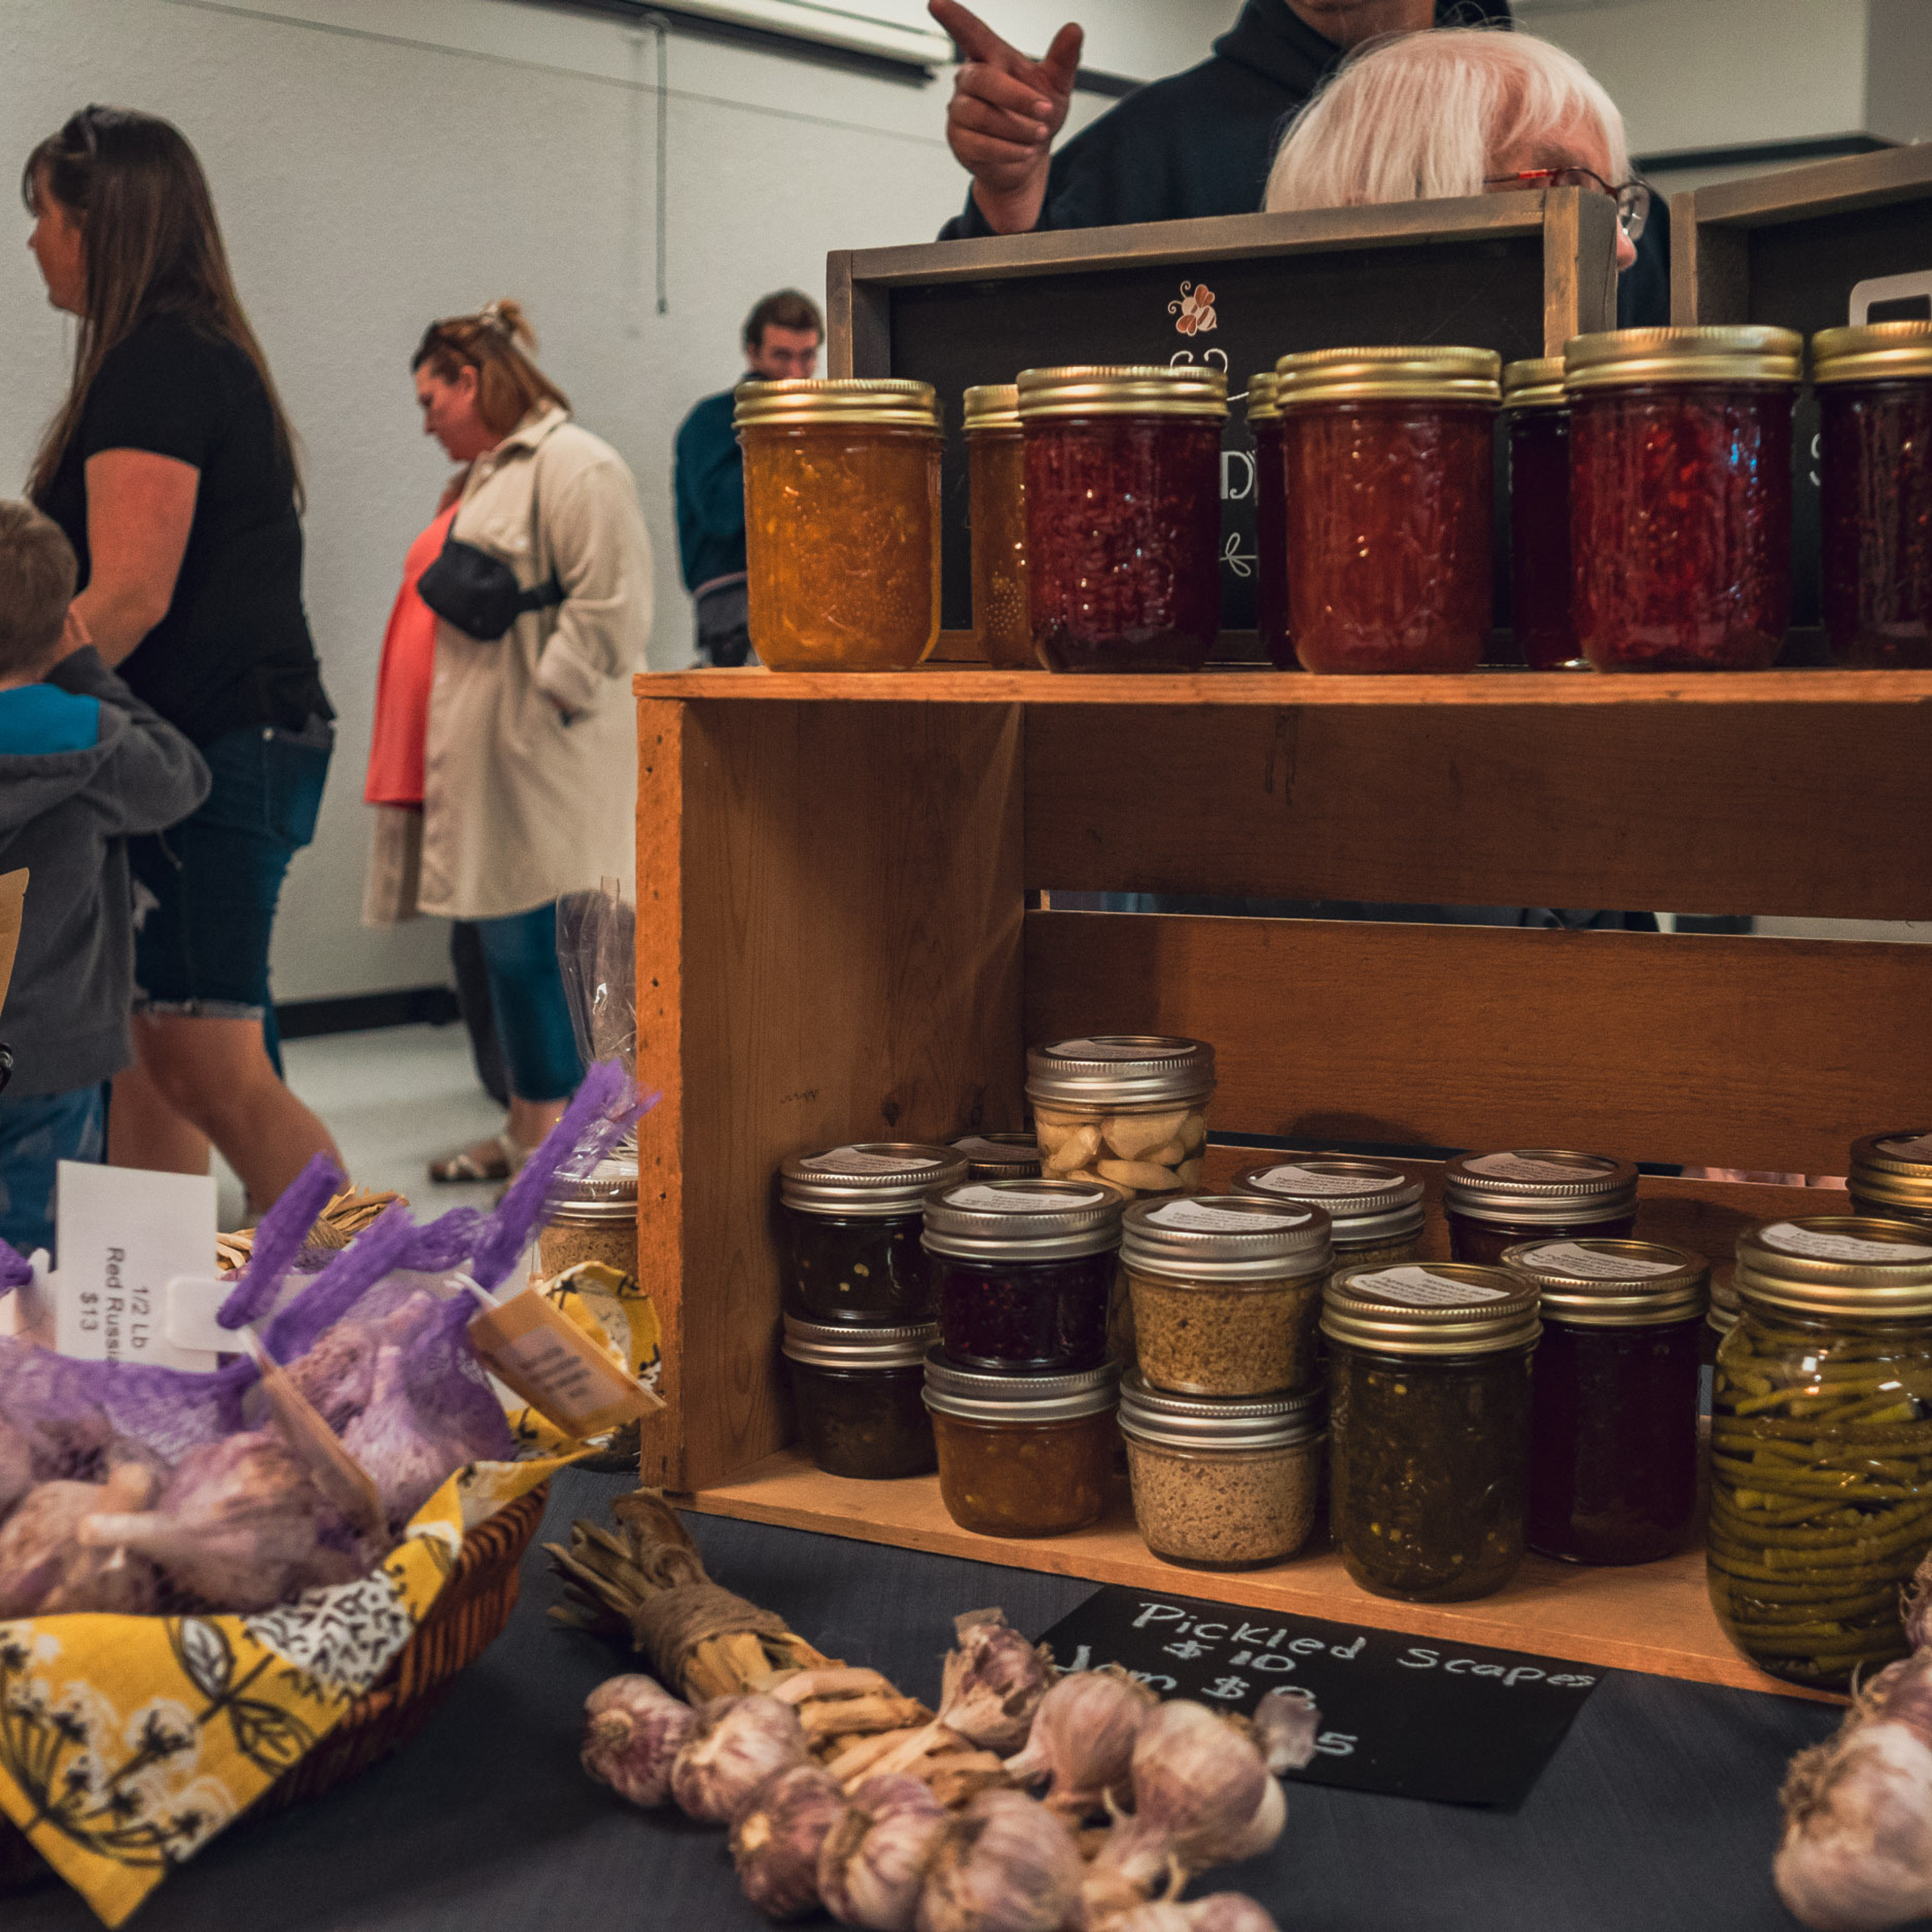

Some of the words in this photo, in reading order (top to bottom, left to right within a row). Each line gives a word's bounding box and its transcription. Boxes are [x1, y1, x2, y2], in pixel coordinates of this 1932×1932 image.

[106, 1247, 125, 1288] Red
[80, 1292, 100, 1331] $13
[131, 1287, 149, 1315] 1/2
[131, 1324, 149, 1348] Lb
[1132, 1603, 1367, 1660] Pickled
[1397, 1647, 1595, 1687] Scapes
